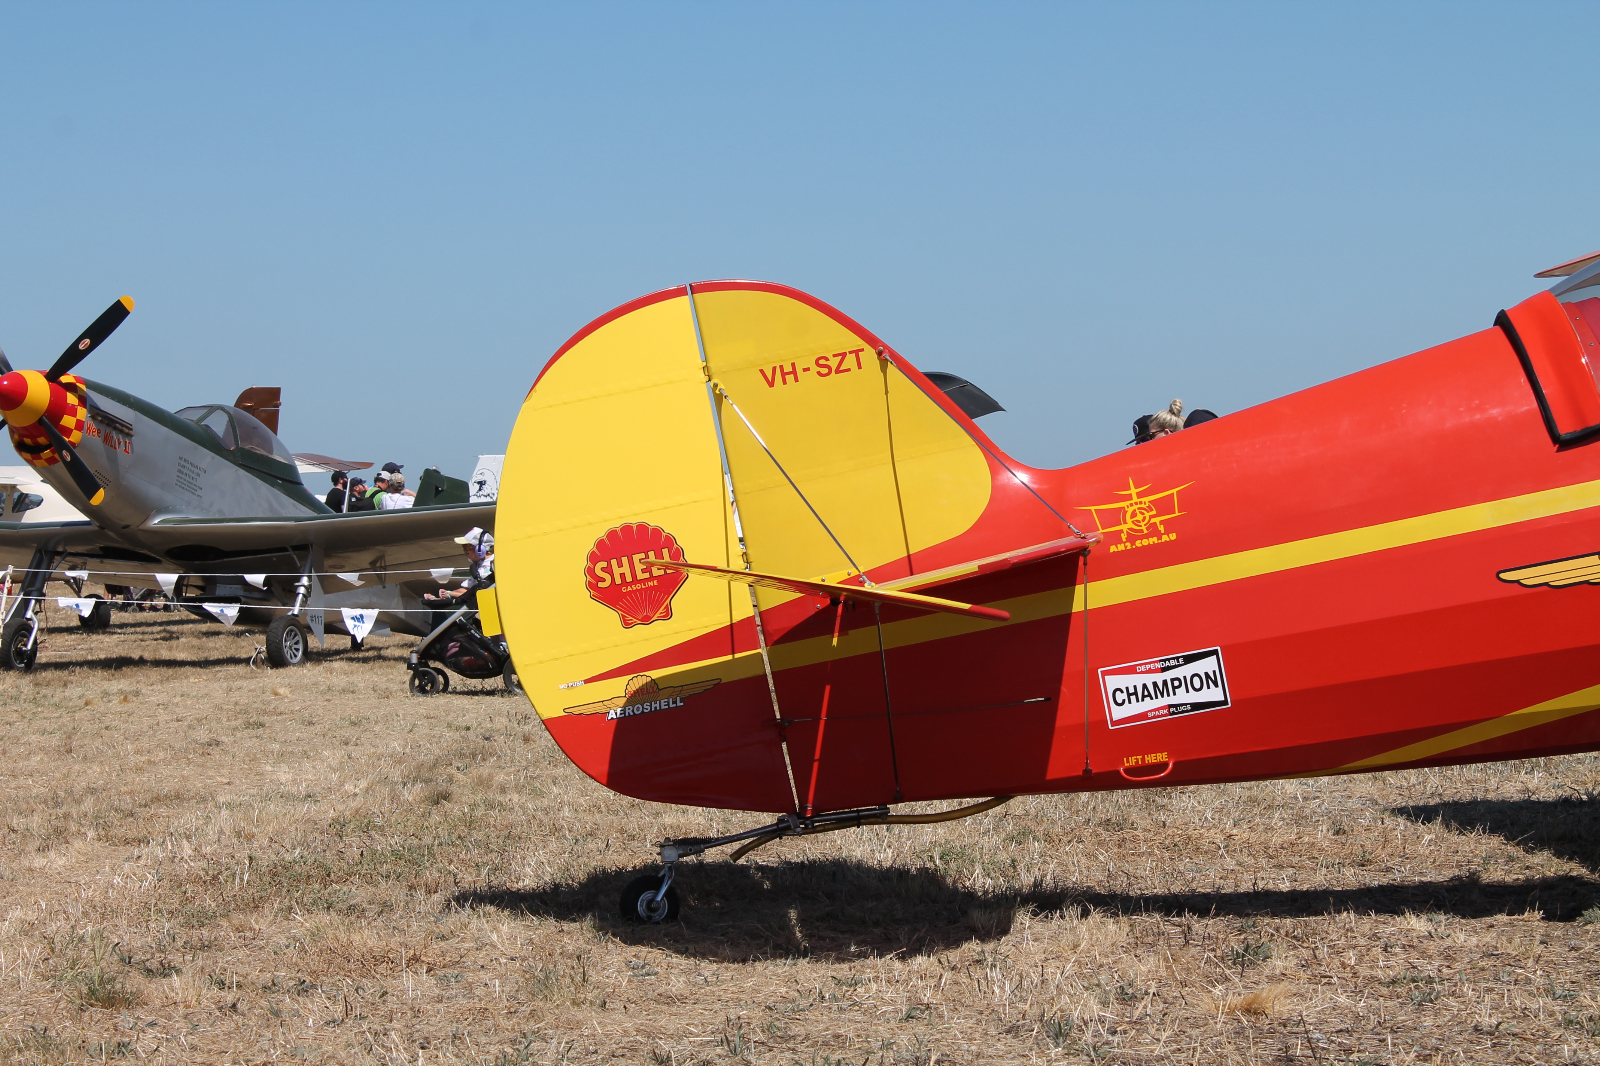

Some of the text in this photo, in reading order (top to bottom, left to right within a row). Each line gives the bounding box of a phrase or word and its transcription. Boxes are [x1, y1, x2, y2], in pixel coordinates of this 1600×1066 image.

[758, 347, 865, 389] VH-SZT
[621, 580, 659, 593] GASOLINE
[1136, 657, 1185, 673] DEPENDABLE
[568, 680, 585, 688] PUSH
[627, 685, 658, 698] SHELL
[1111, 669, 1220, 708] CHAMPION
[606, 696, 685, 720] AEROSHELL
[1147, 704, 1192, 718] SPARK PLUGS
[1123, 751, 1169, 767] LIFT HERE
